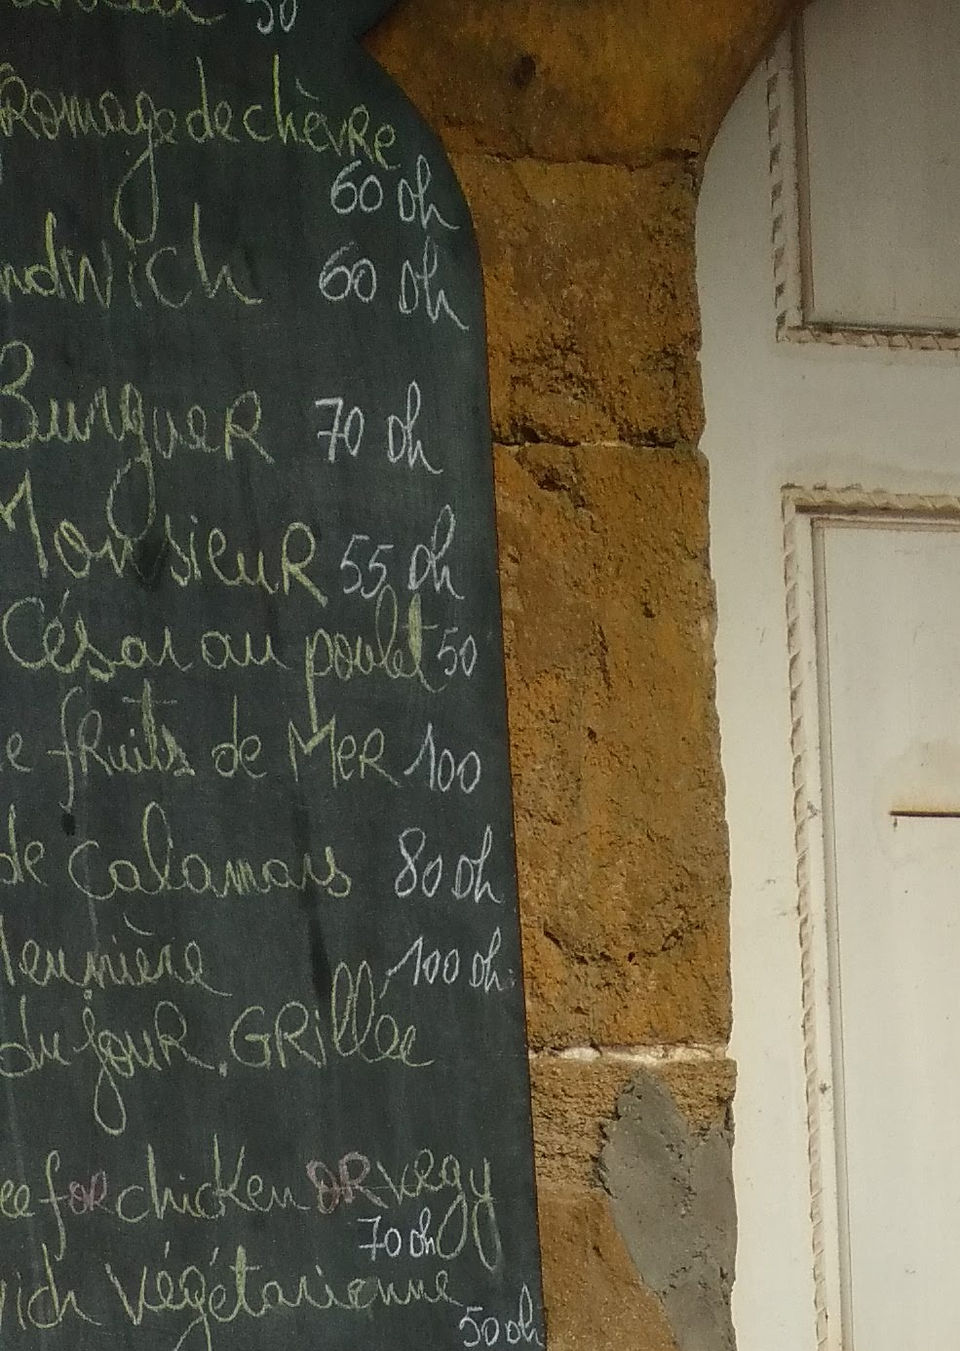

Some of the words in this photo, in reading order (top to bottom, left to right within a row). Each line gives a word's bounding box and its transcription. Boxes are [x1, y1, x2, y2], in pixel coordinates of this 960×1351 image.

[331, 160, 383, 214] 60
[319, 241, 377, 303] 60
[315, 397, 364, 462] 70
[340, 533, 394, 599] 55
[437, 627, 477, 676] 50
[211, 694, 267, 779] de
[404, 722, 481, 793] 100
[395, 827, 443, 897] 80
[357, 1215, 401, 1261] 70
[0, 1243, 102, 1330] ich
[460, 1306, 500, 1347] 50
